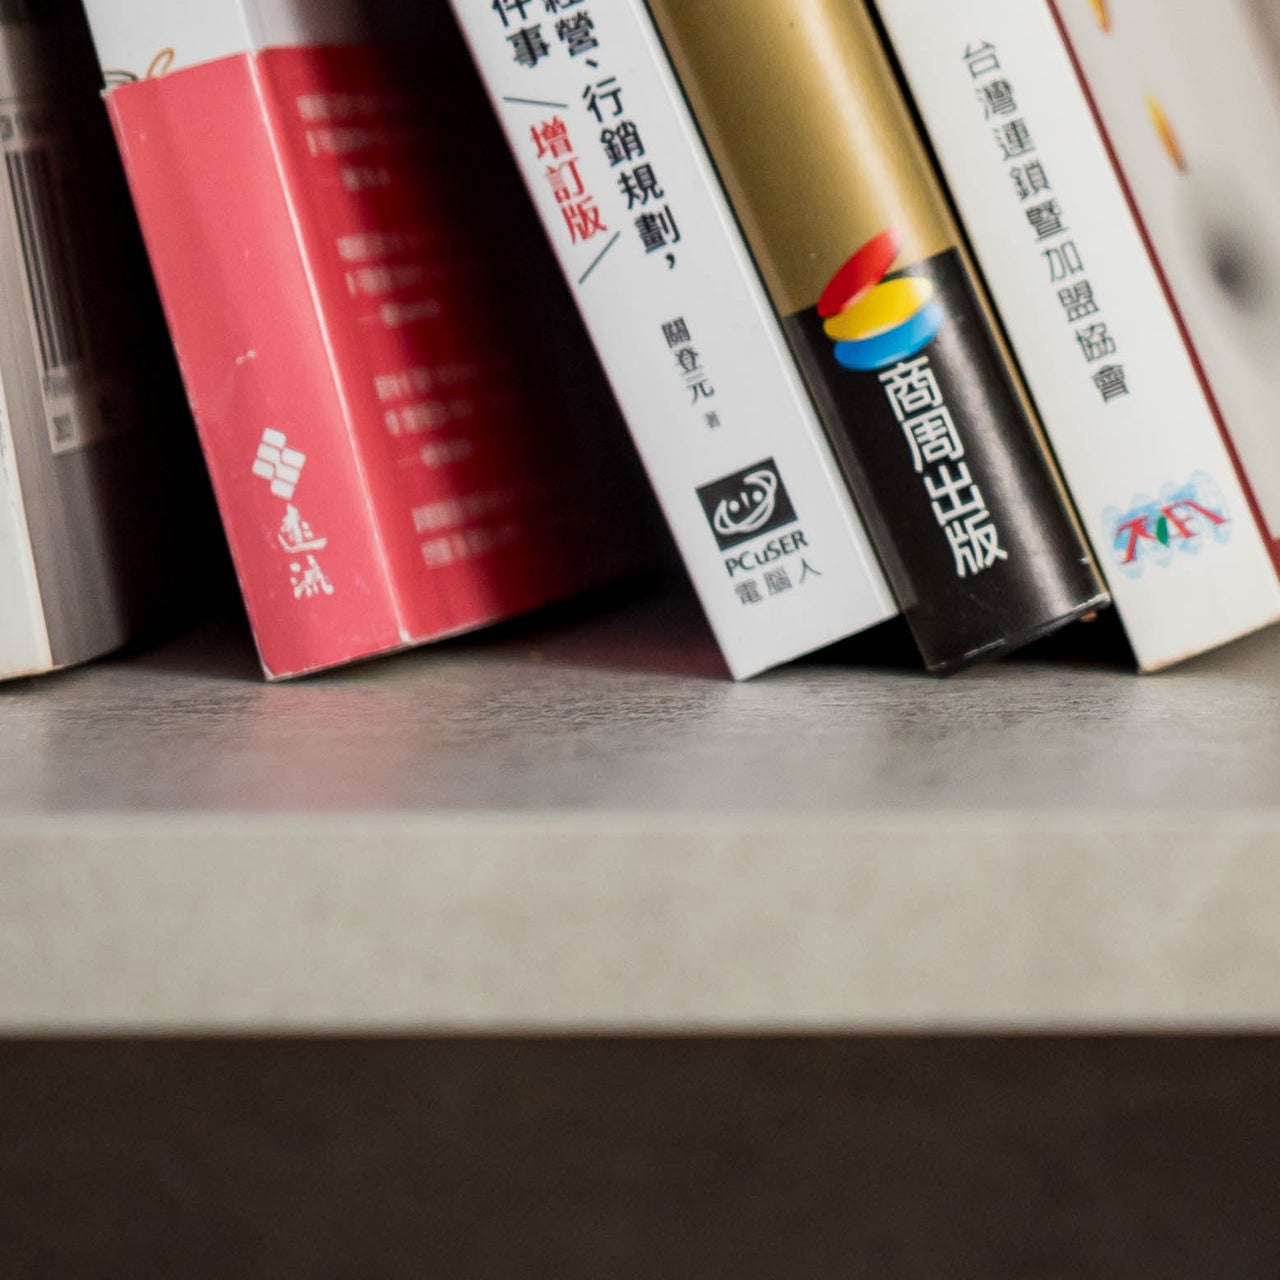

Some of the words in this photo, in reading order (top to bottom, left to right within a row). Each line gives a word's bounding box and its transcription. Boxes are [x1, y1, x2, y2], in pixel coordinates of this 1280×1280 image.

[530, 114, 608, 245] 增訂版
[962, 39, 1130, 404] 台灣連鎖暨加盟協會
[878, 355, 1008, 578] 商周出版
[735, 557, 822, 606] 電腦人
